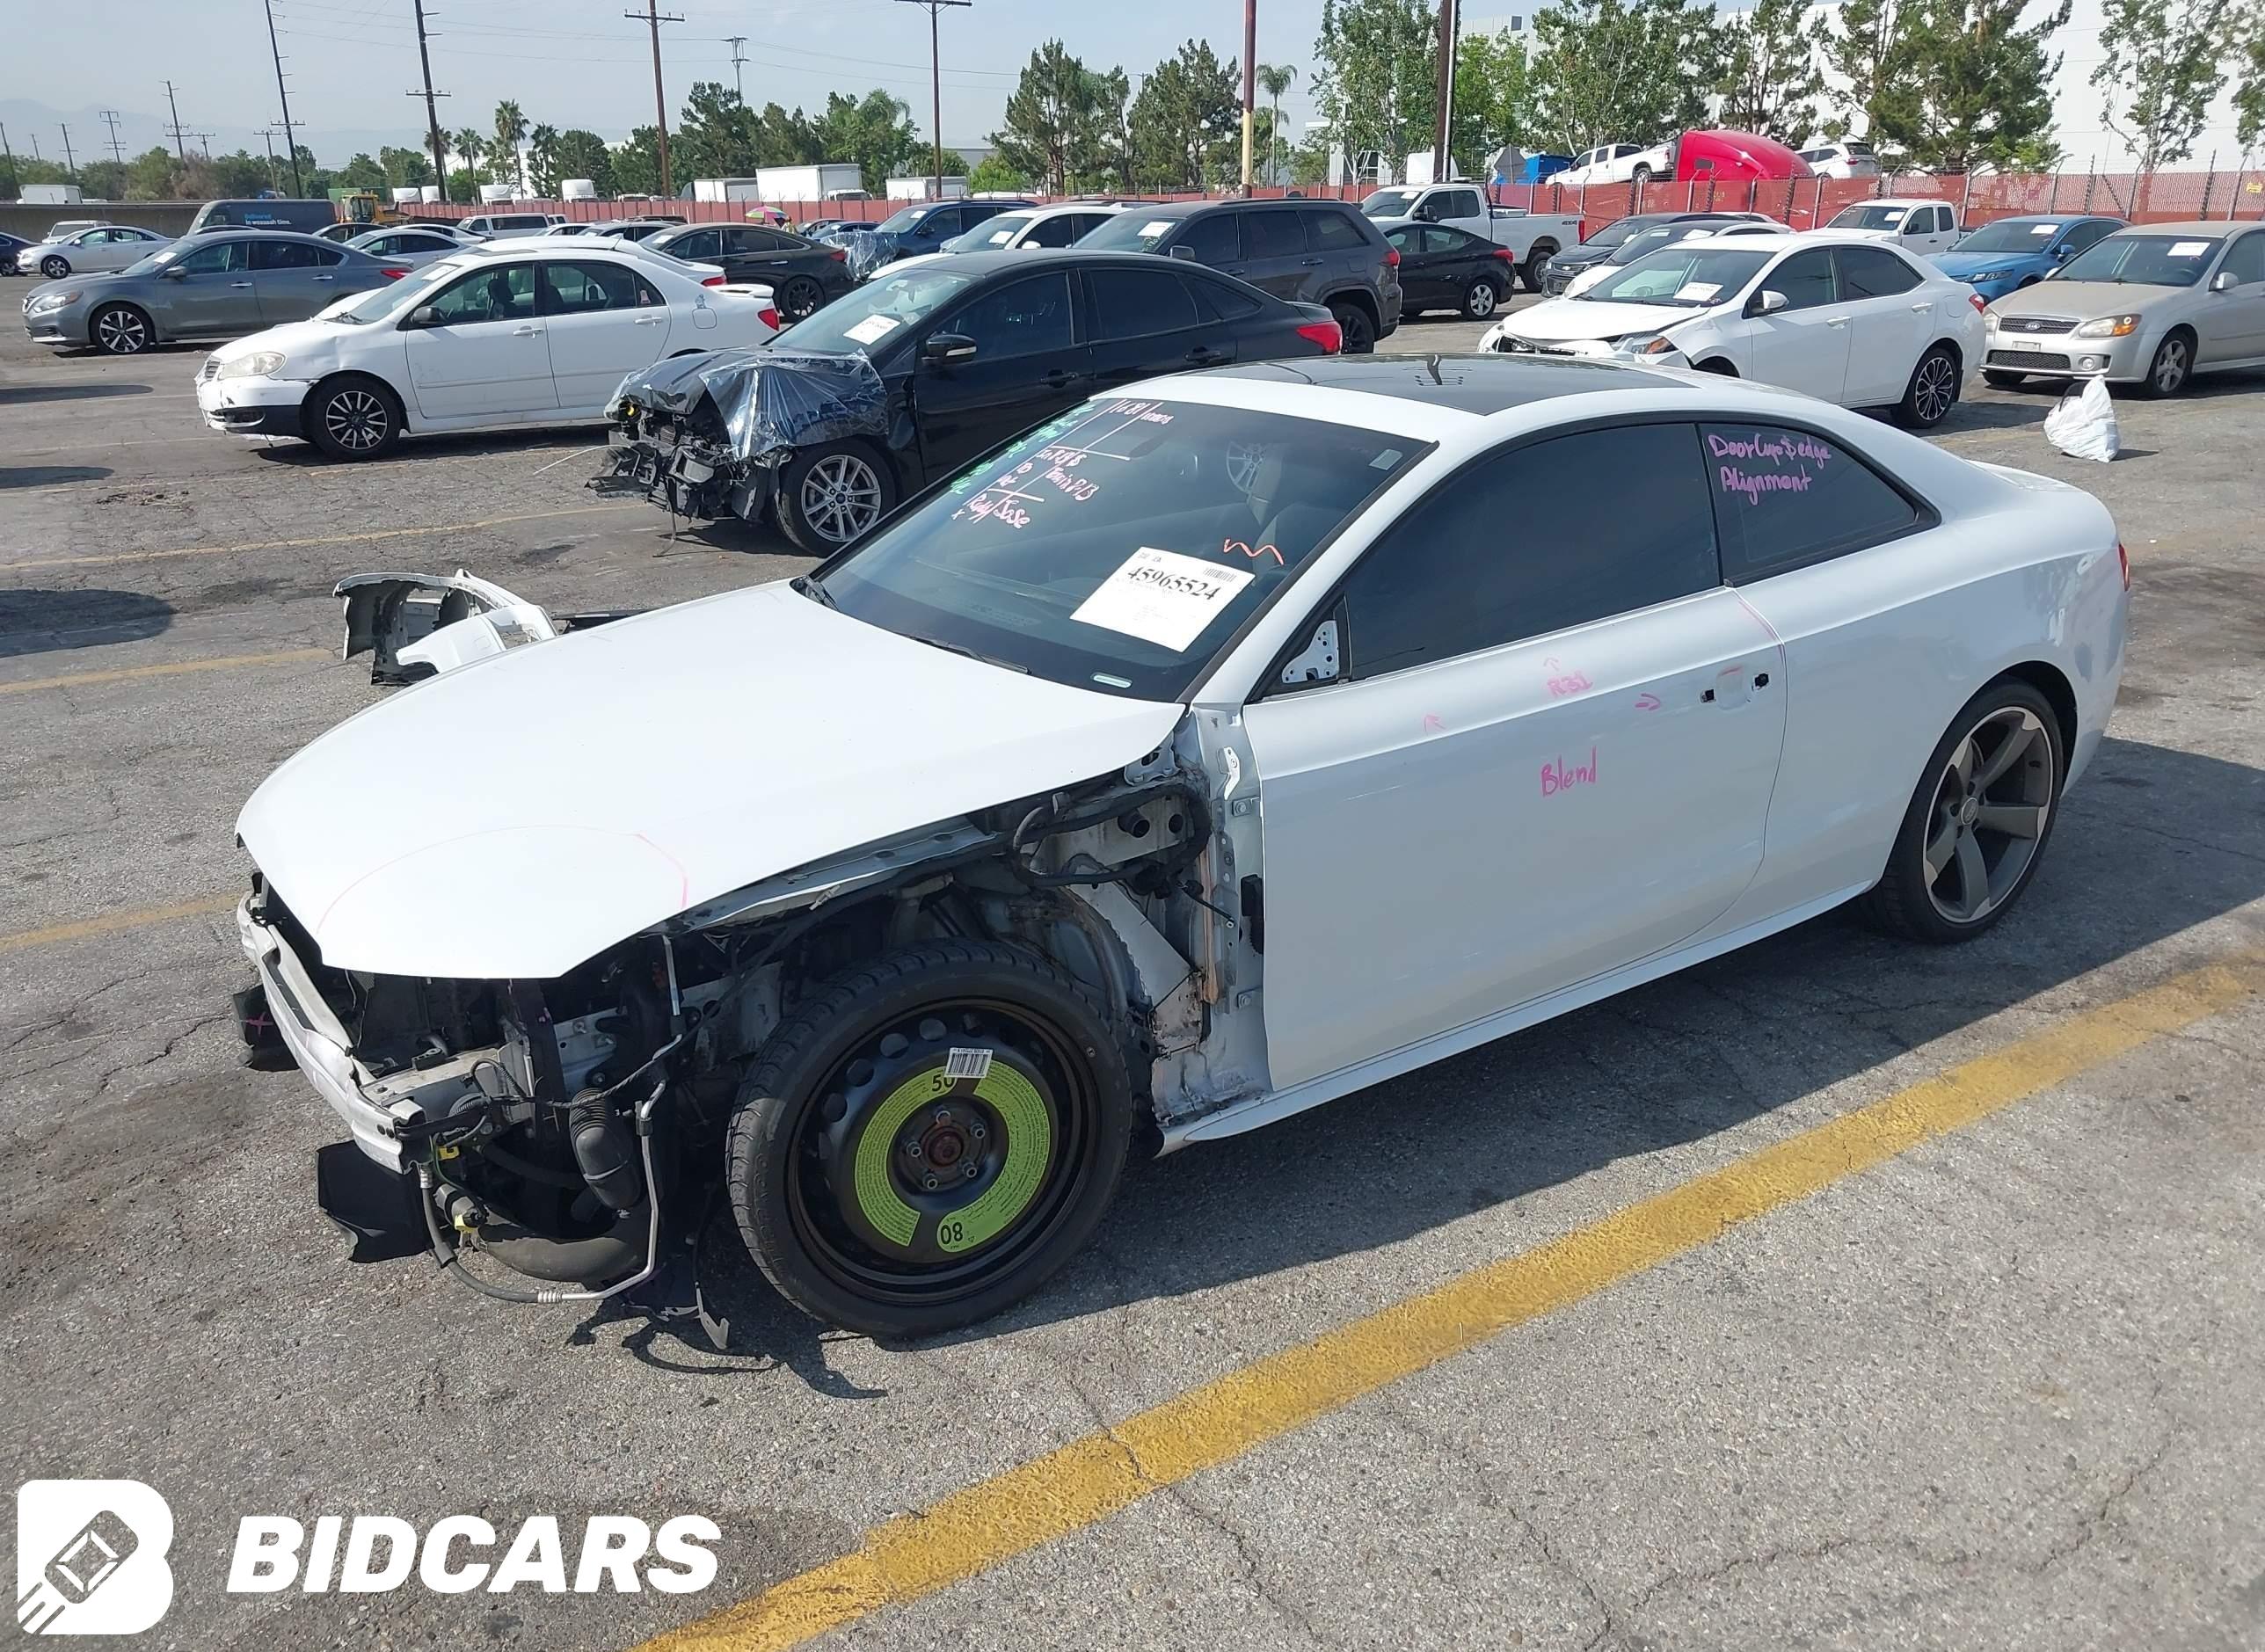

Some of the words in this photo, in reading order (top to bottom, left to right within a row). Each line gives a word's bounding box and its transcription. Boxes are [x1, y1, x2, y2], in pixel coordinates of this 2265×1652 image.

[1720, 463, 1812, 506] Alignment
[1127, 567, 1221, 600] 45965524
[1540, 745, 1597, 797] Blend
